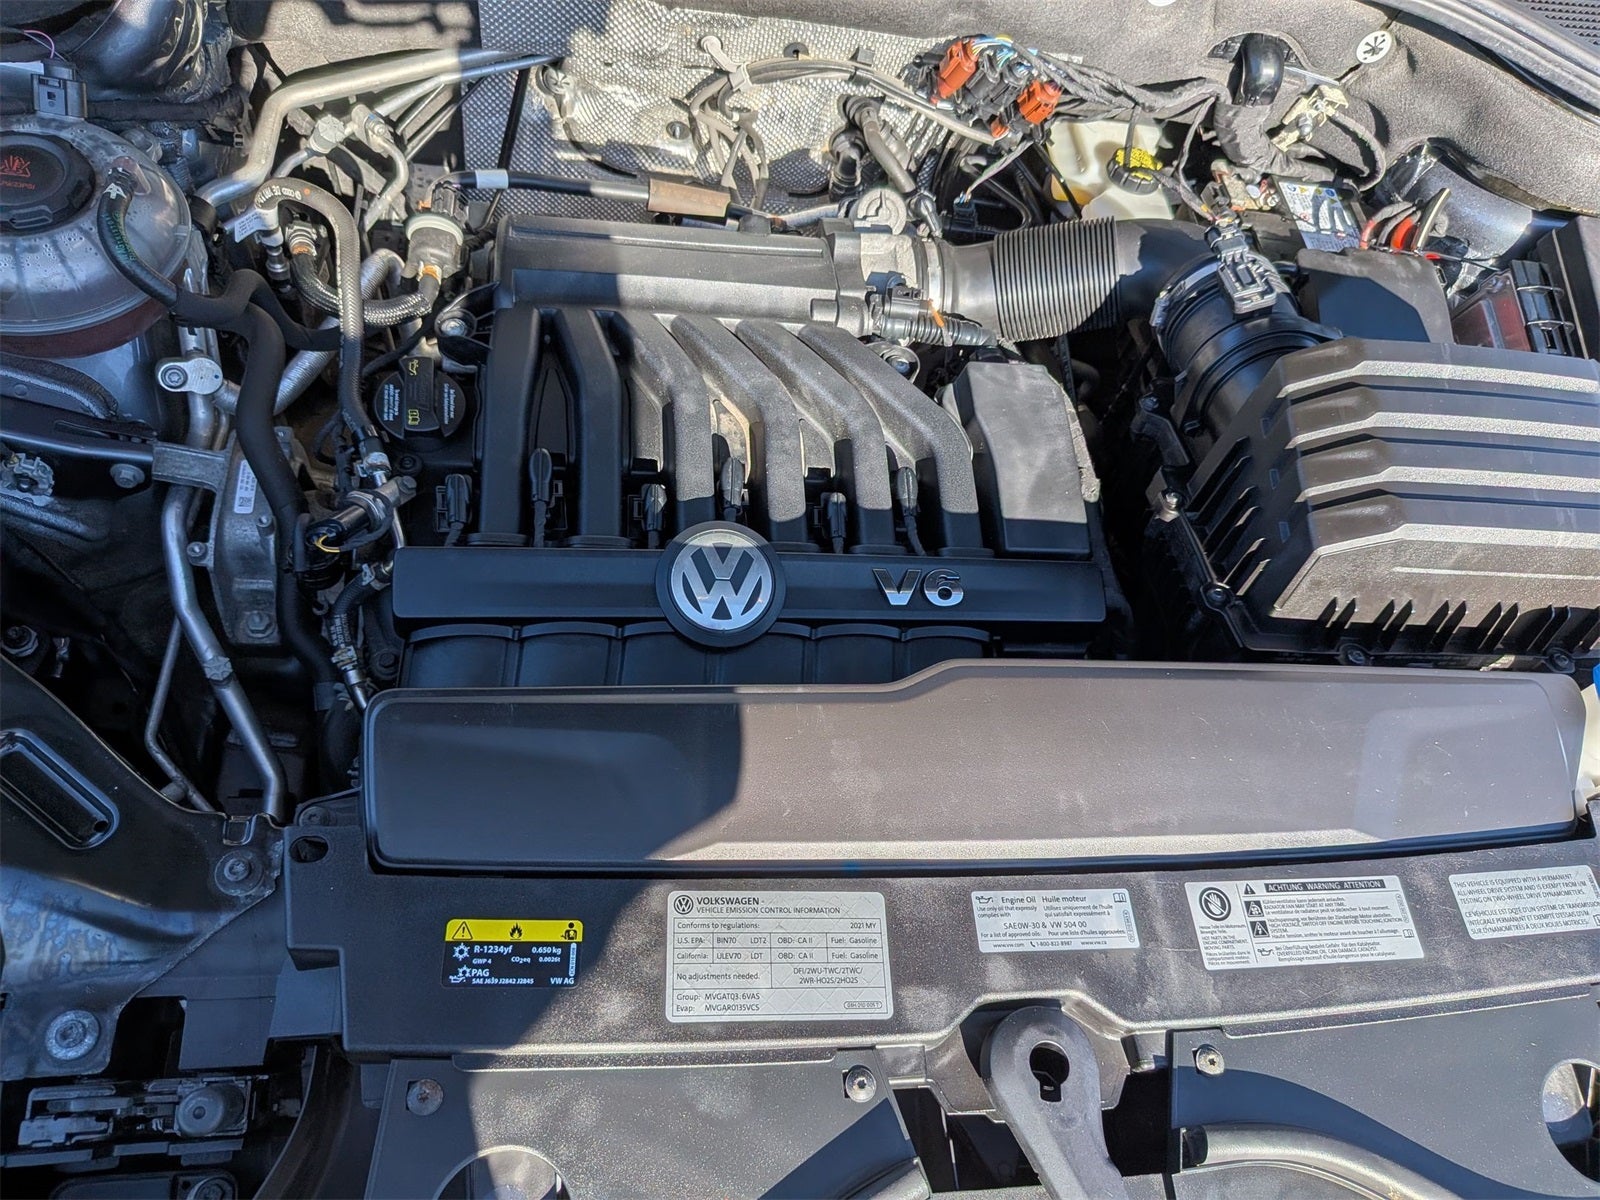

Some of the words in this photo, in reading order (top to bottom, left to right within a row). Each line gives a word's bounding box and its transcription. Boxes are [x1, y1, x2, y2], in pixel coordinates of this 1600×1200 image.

[872, 568, 964, 607] V6
[1494, 877, 1521, 885] EQUIPPED
[1267, 883, 1303, 891] ACHTUNG
[1305, 881, 1340, 889] WARNING
[1342, 880, 1381, 888] ATTENTION
[696, 896, 760, 906] VOLKSWAGEN
[1001, 896, 1024, 905] Engine
[696, 906, 724, 914] VEHICLE
[726, 906, 759, 914] EMISSION
[760, 906, 792, 914] CONTROL
[794, 906, 840, 914] INFORMATION
[677, 921, 710, 929] Conforms
[720, 922, 760, 931] regulations:
[1544, 920, 1563, 928] ROUES
[474, 944, 513, 955] R-1234yf
[531, 946, 552, 954] 0.650
[552, 946, 562, 956] kg
[676, 952, 709, 960] California:
[716, 952, 742, 960] ULEV70
[750, 952, 764, 960] LDT
[778, 952, 796, 960] OBD:
[798, 952, 808, 960] CA
[832, 952, 848, 960] Fuel:
[850, 952, 879, 960] Gasoline
[472, 968, 490, 976] PAG
[688, 973, 732, 982] adjustments
[799, 976, 858, 984] 2WR-HO2S/2HO2S
[676, 993, 700, 1002] Group:
